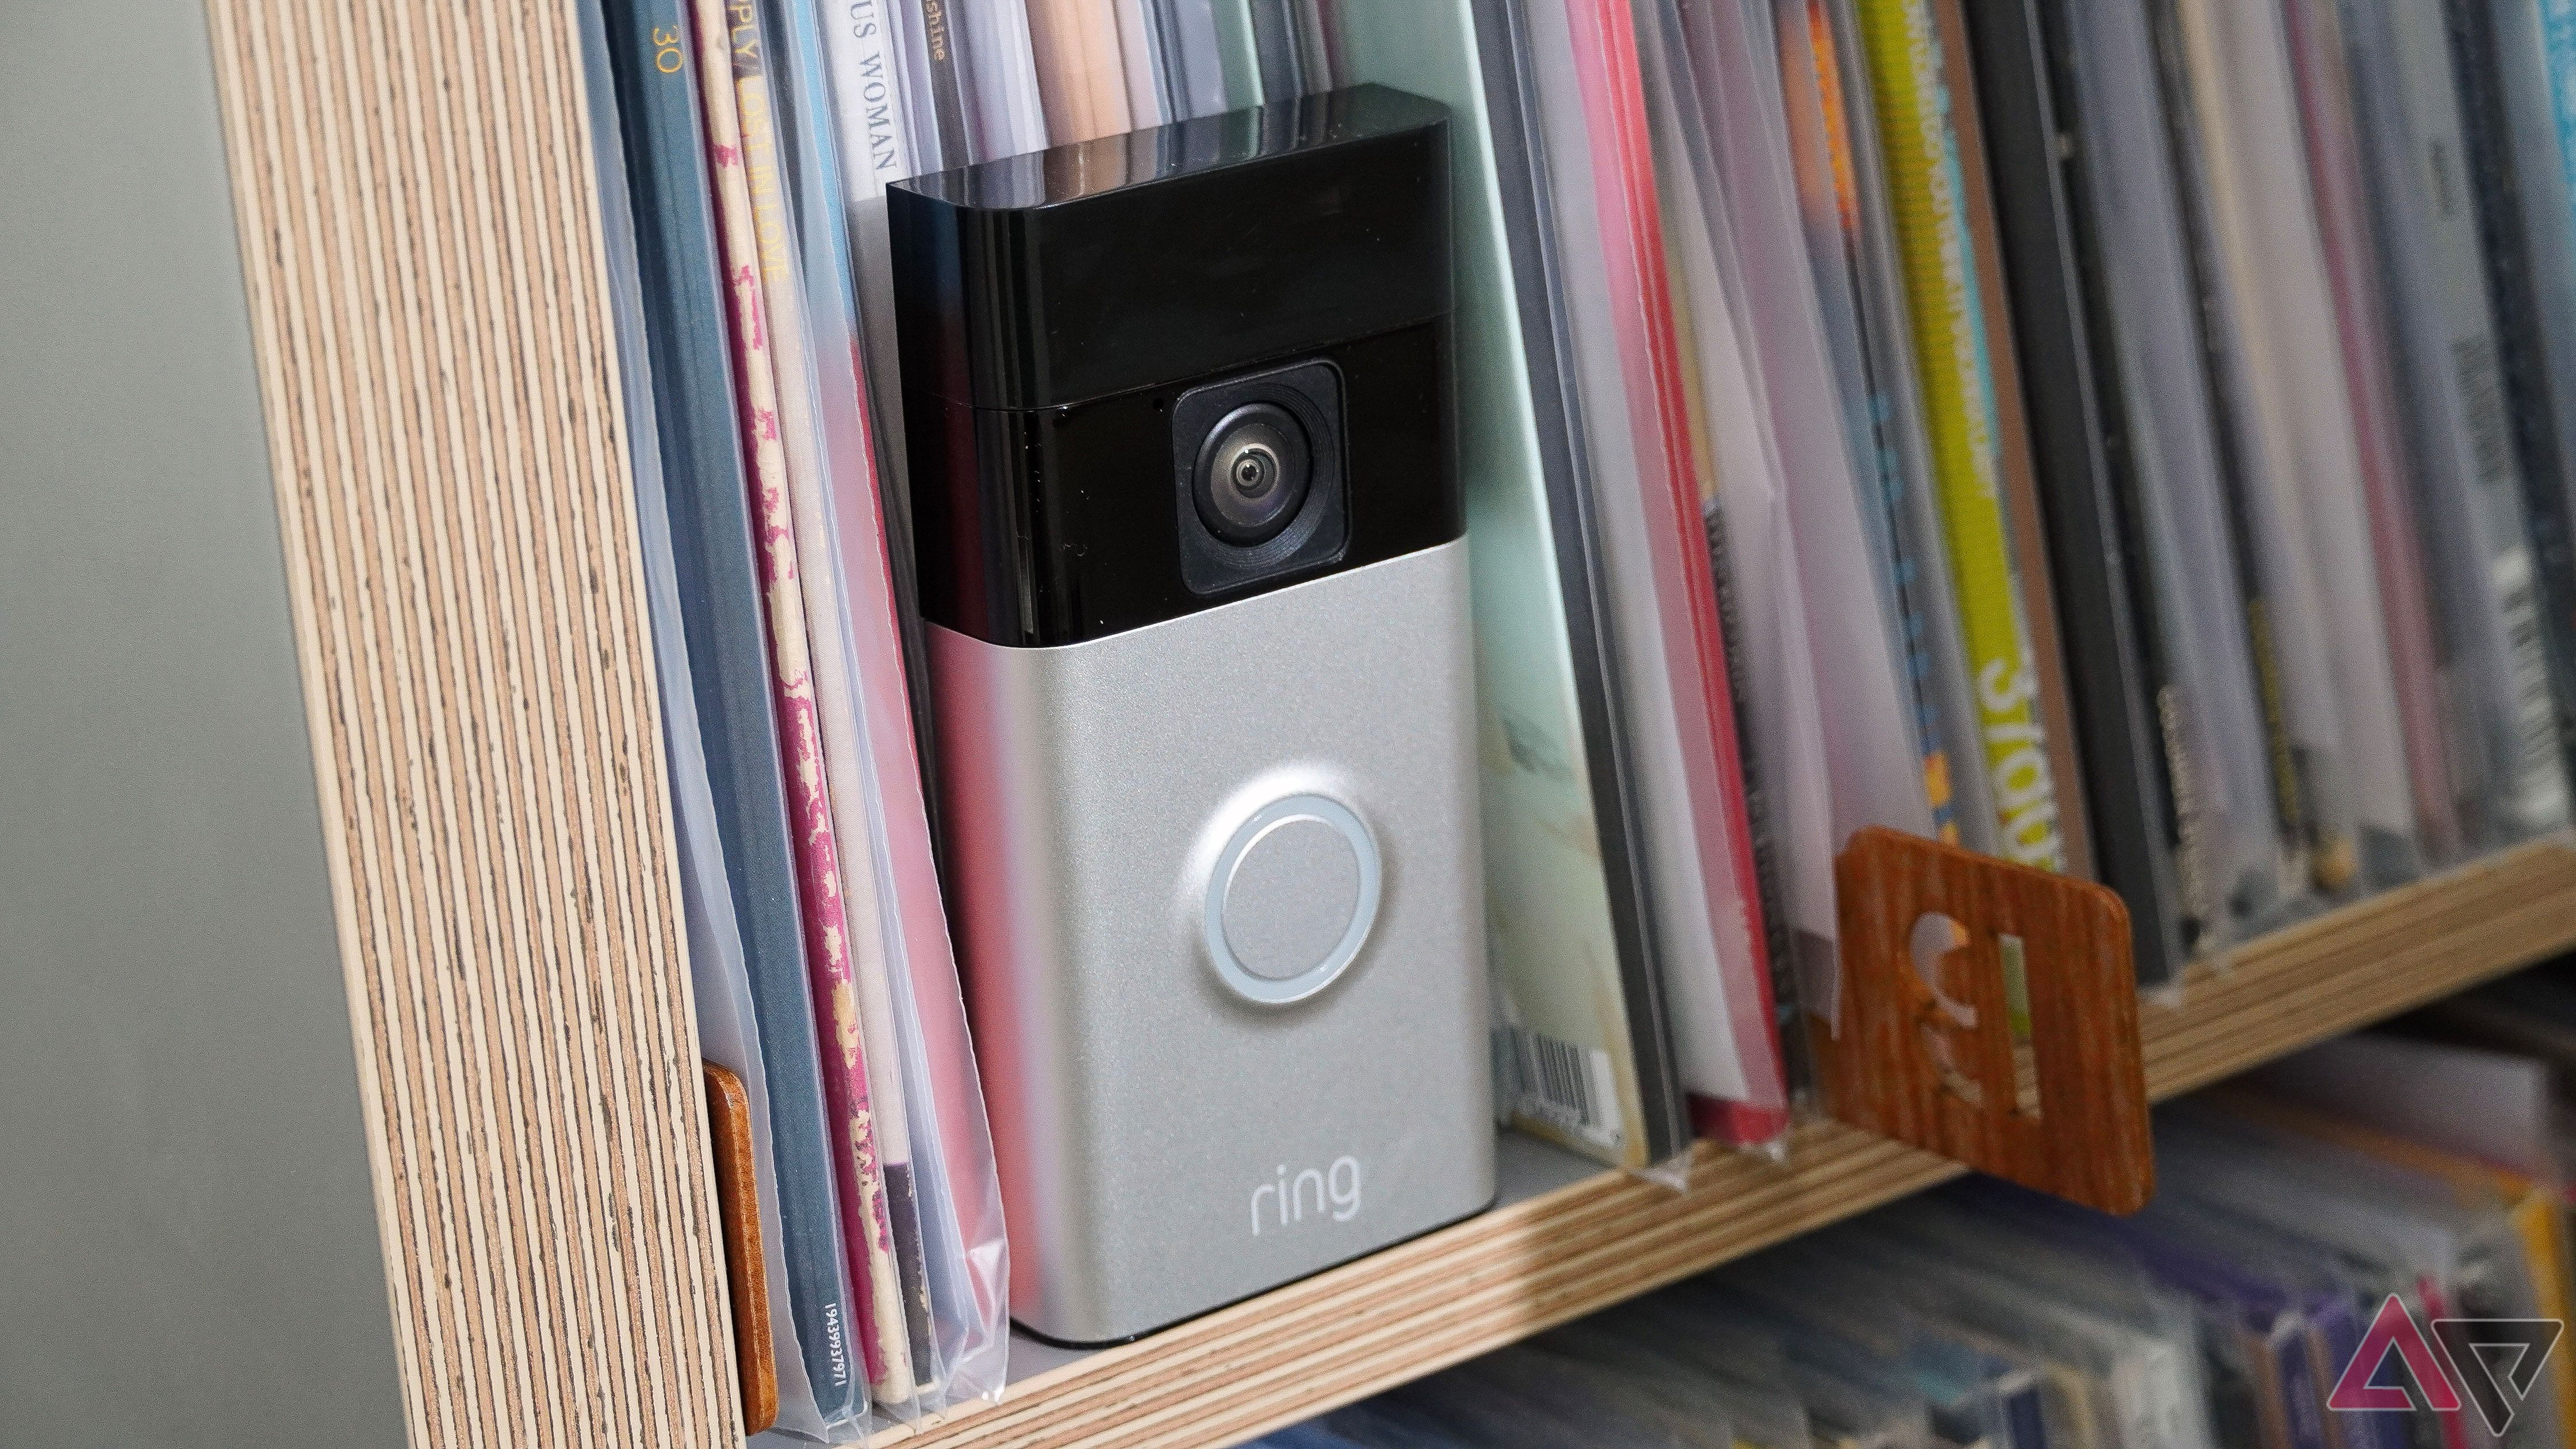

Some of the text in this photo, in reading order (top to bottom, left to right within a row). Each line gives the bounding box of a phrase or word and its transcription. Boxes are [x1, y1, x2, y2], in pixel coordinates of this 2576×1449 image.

[653, 25, 684, 74] 30
[925, 0, 946, 61] shine
[729, 0, 788, 282] PLY LOST IN LOVE
[860, 51, 898, 171] WOMAN
[1250, 1156, 1362, 1236] ring
[825, 1304, 847, 1386] 19439937971
